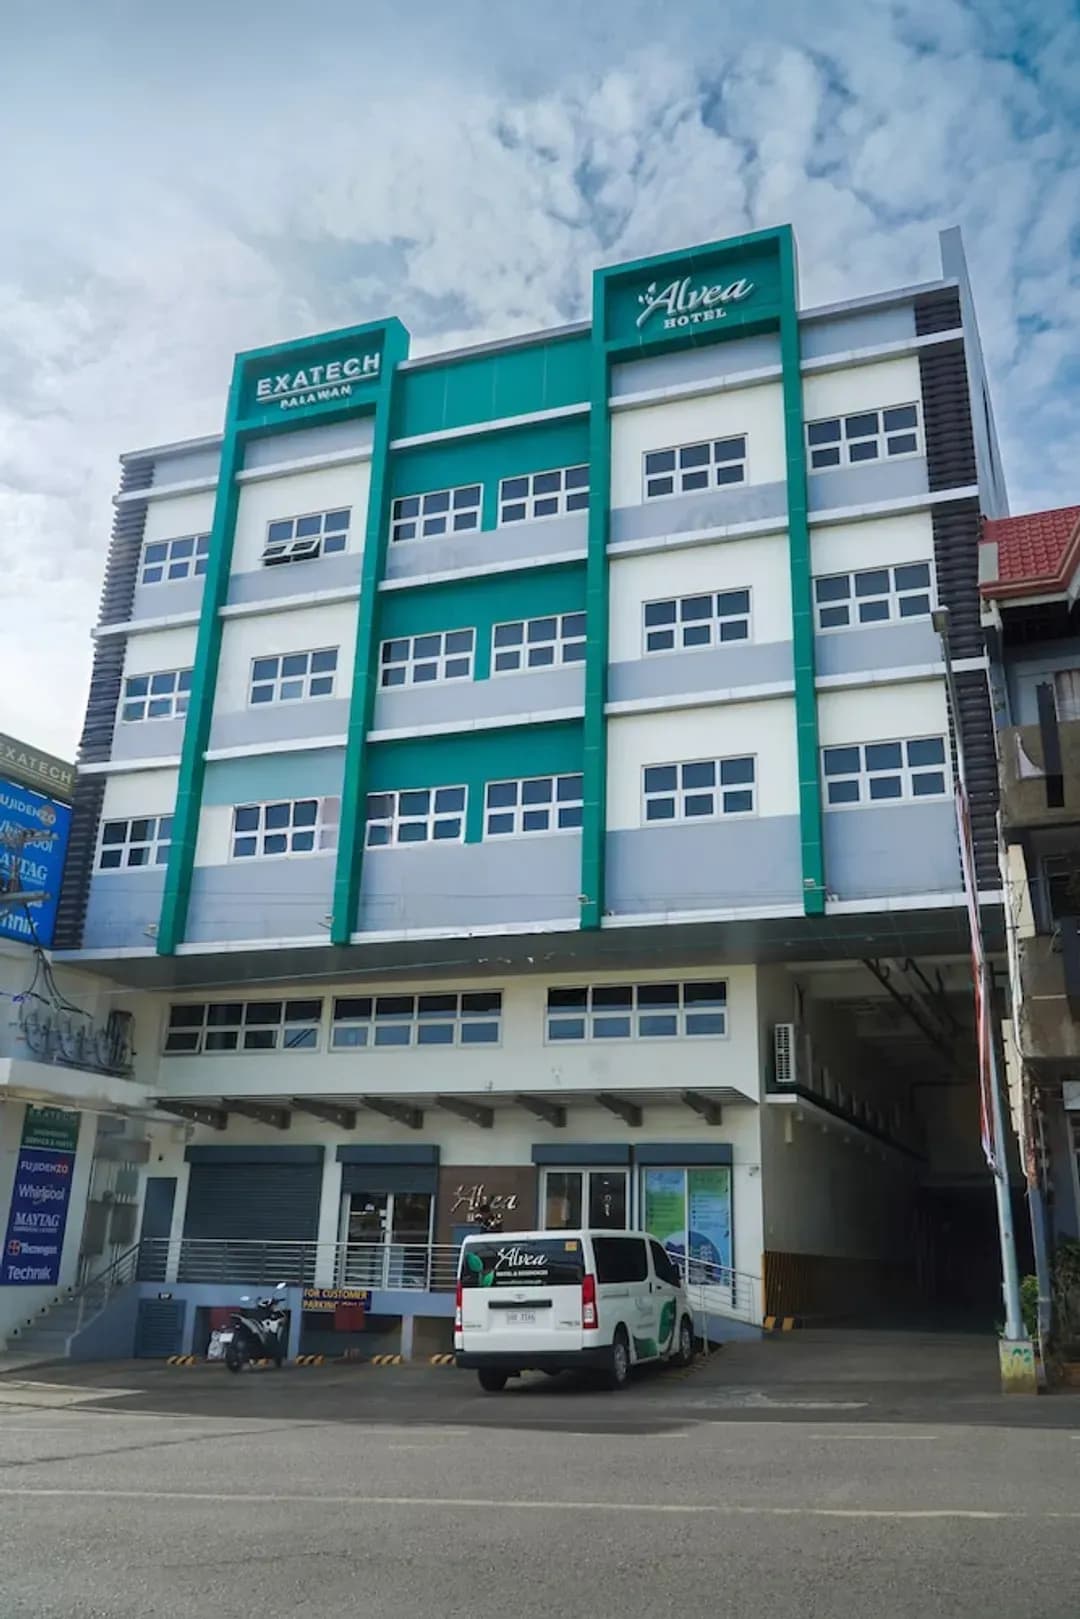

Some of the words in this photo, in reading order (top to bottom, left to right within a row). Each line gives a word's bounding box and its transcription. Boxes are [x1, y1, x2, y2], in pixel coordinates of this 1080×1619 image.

[636, 277, 753, 327] Alvea
[664, 308, 727, 329] HOTEL
[257, 352, 380, 396] EXATECH
[280, 384, 352, 410] PALAWAN
[20, 1160, 68, 1174] FUJIDENZO
[18, 1184, 65, 1202] Whirlpool
[15, 1211, 60, 1227] MAYTAG
[495, 1247, 549, 1269] Alvea
[8, 1265, 51, 1281] Technik
[304, 1288, 320, 1297] FOR
[322, 1288, 368, 1299] CUSTOMER
